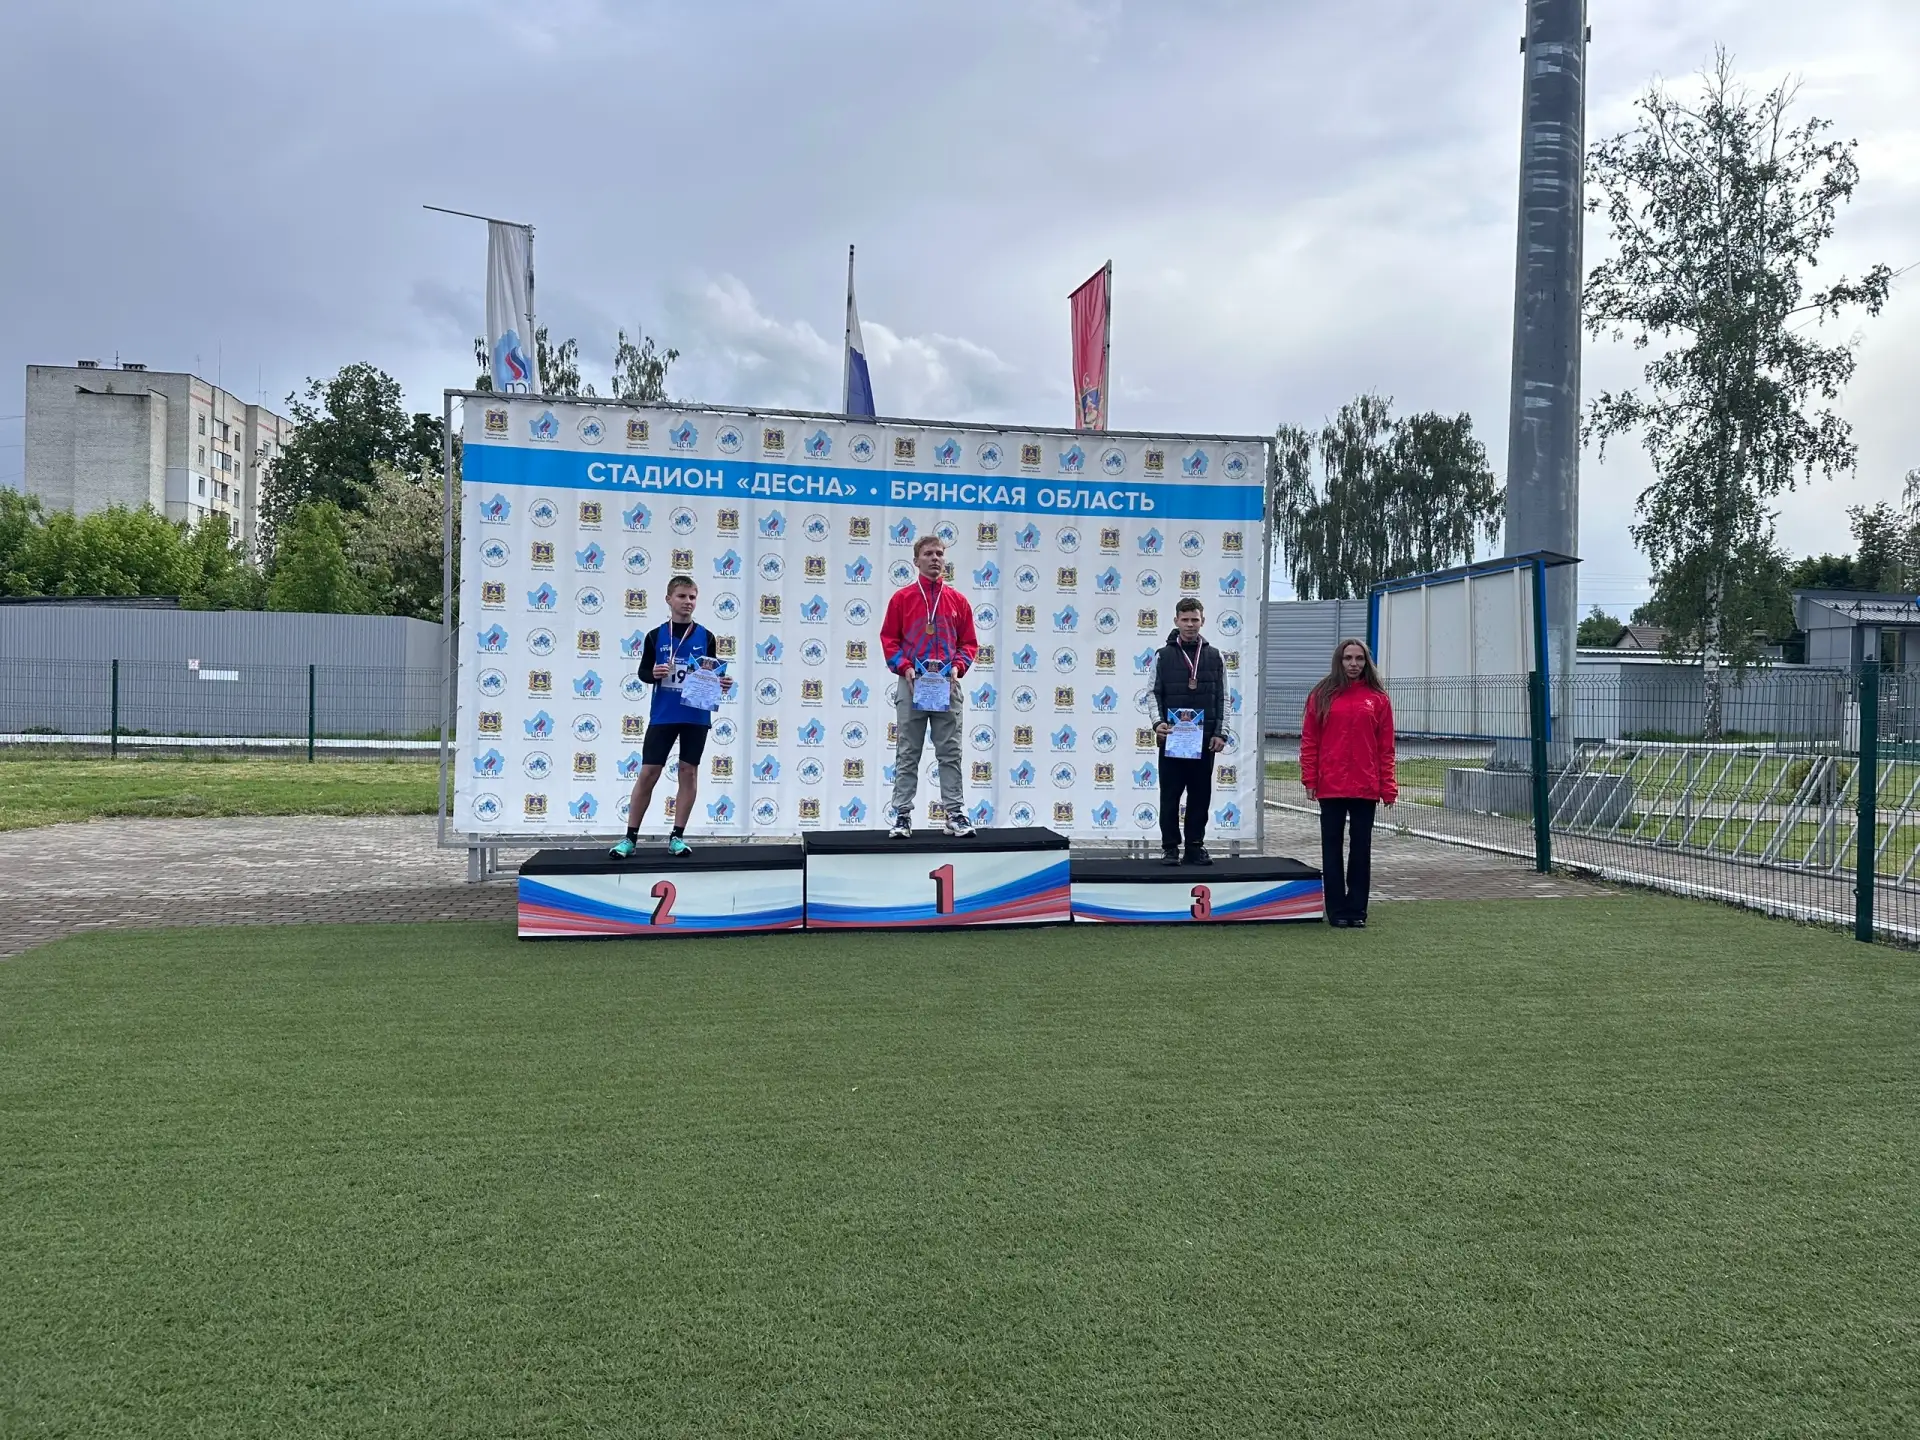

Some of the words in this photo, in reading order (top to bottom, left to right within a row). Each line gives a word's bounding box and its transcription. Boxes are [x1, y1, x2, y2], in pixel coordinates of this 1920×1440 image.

[587, 462, 724, 490] СТАДИОН
[736, 473, 857, 497] «ДЕСНА»
[890, 480, 1026, 506] БРЯНСКАЯ
[1037, 488, 1155, 512] ОБЛАСТЬ
[650, 880, 677, 926] 2
[929, 863, 954, 915] 1
[1190, 884, 1211, 920] 3
